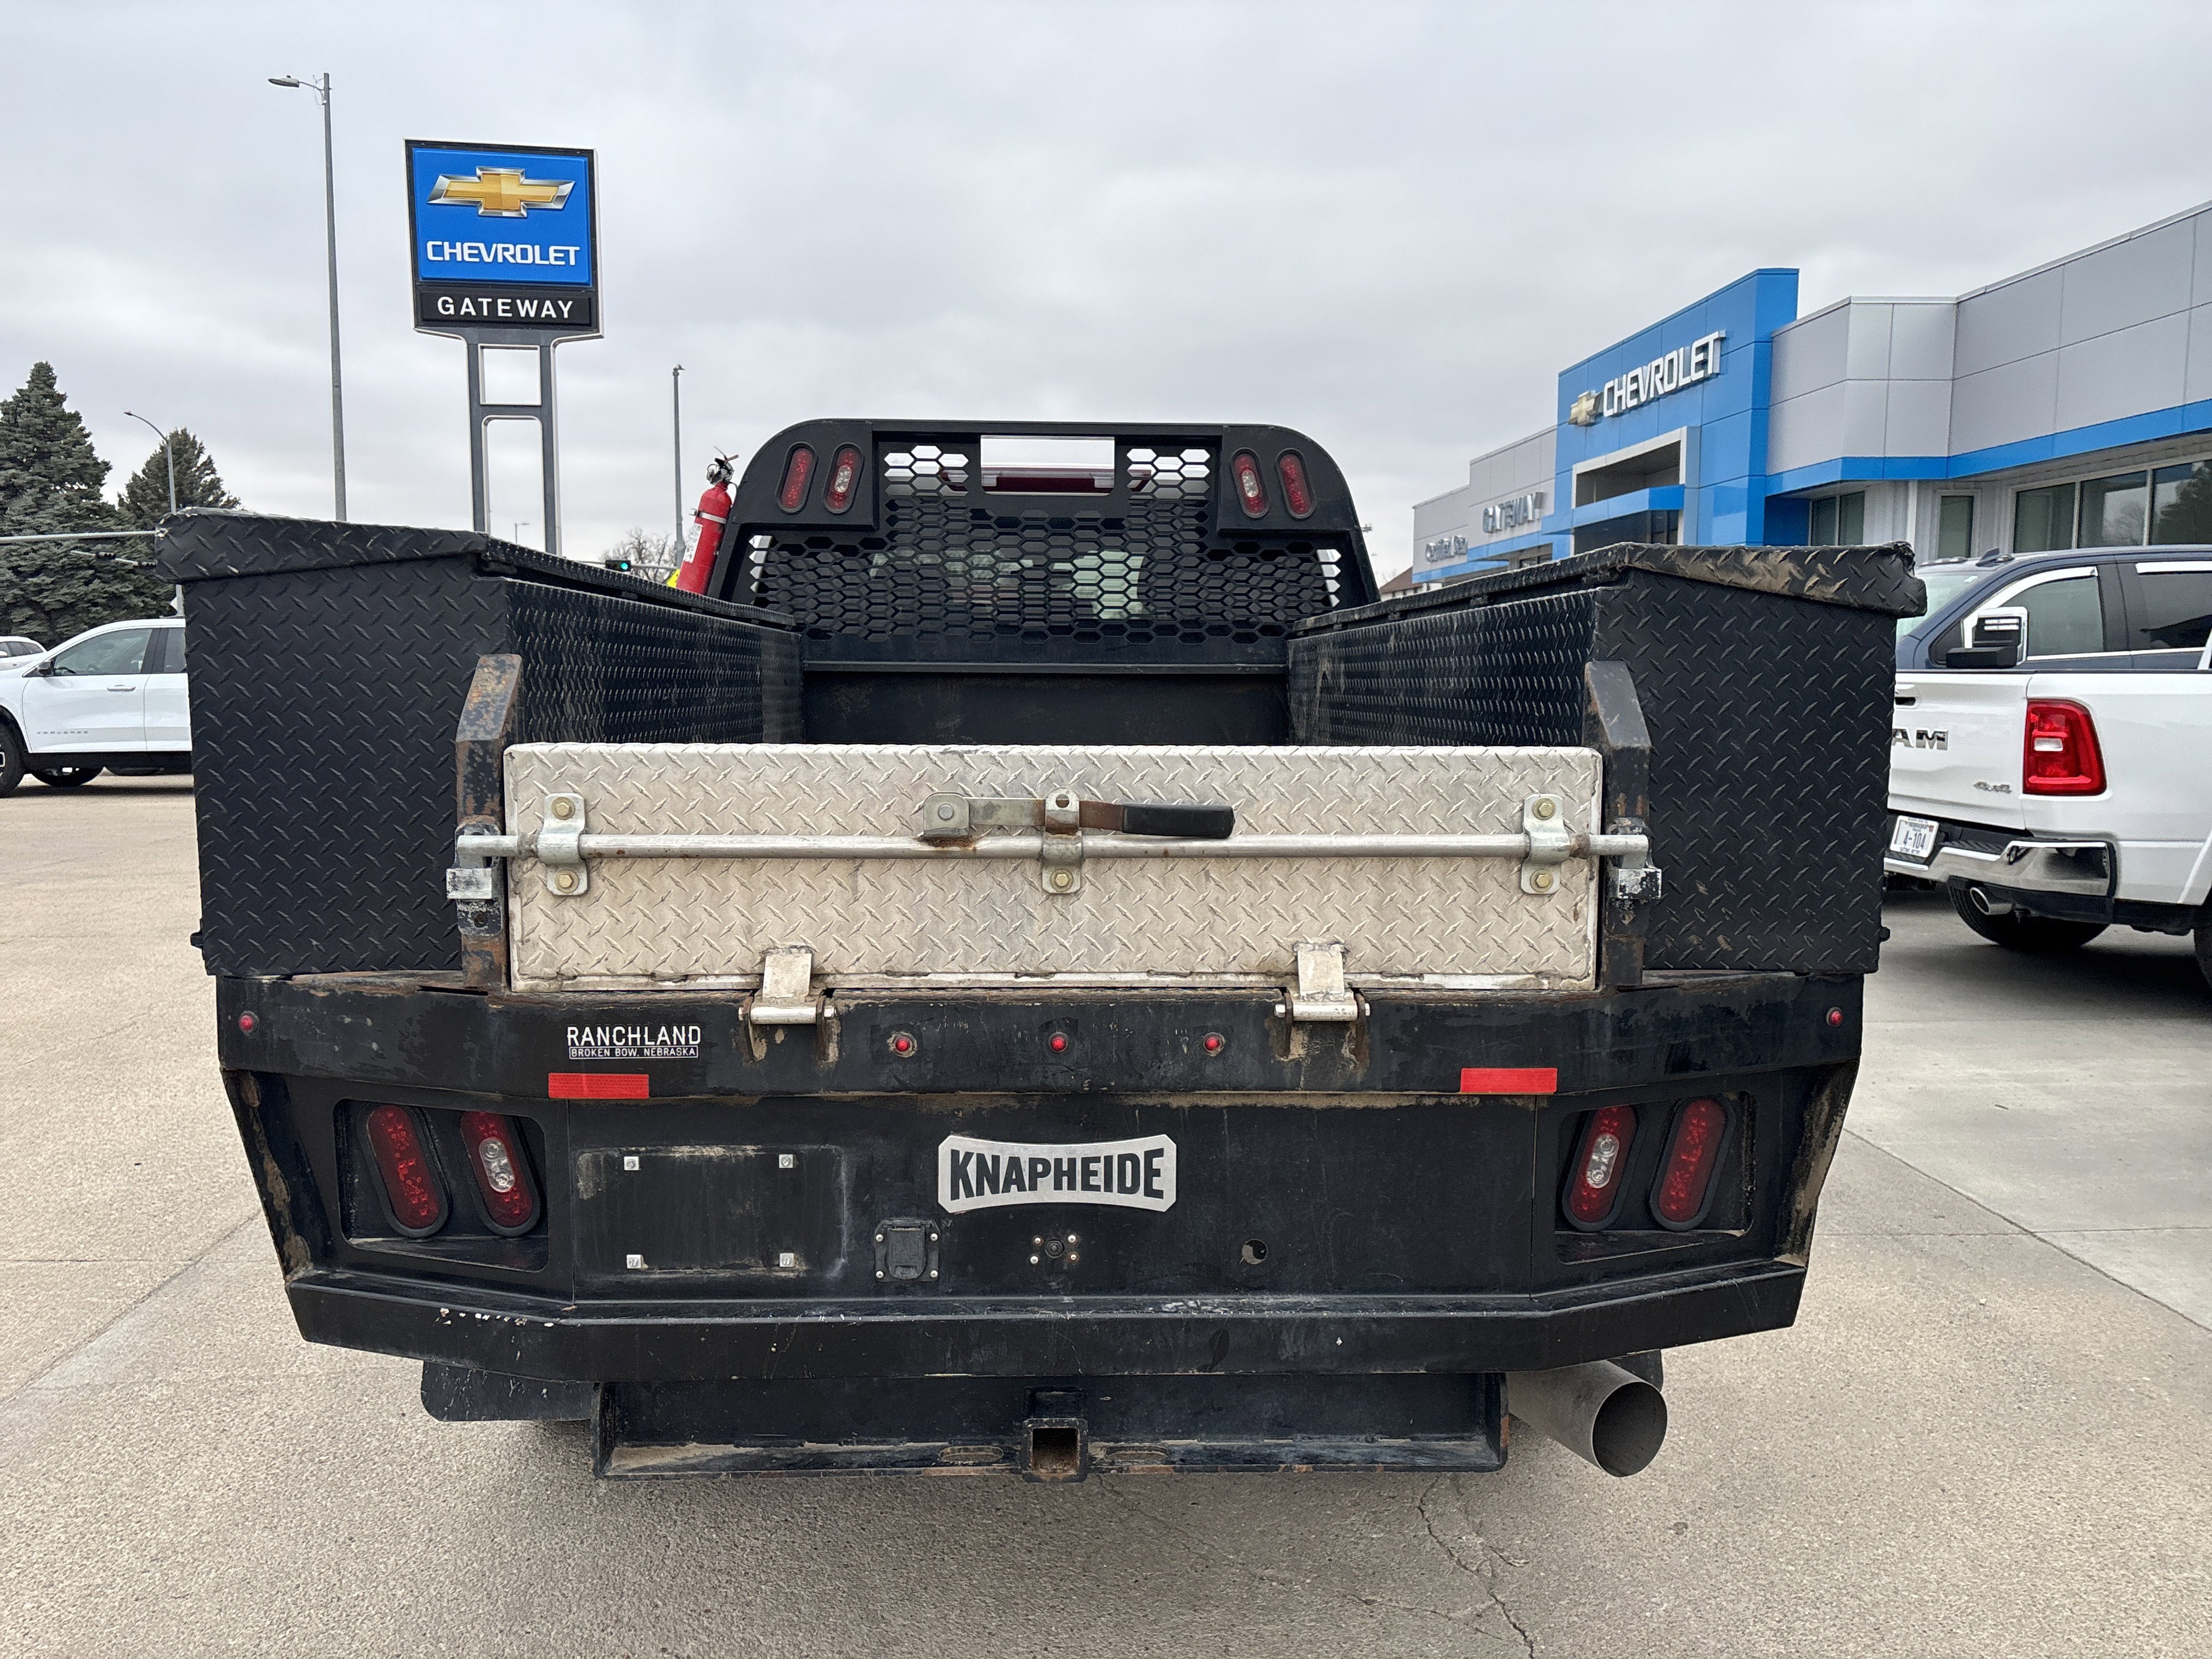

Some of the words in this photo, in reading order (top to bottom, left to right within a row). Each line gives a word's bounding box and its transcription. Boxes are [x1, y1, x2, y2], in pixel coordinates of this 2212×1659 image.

[426, 241, 580, 266] CHEVROLET
[437, 297, 573, 319] GATEWAY
[1603, 330, 1726, 417] CHEVROLET
[1892, 726, 1949, 751] AM
[567, 1025, 701, 1046] RANCHLAND
[571, 1048, 610, 1057] BROKEN
[644, 1047, 696, 1056] NEBRASKA
[950, 1148, 1164, 1201] KNAPHEIDE
